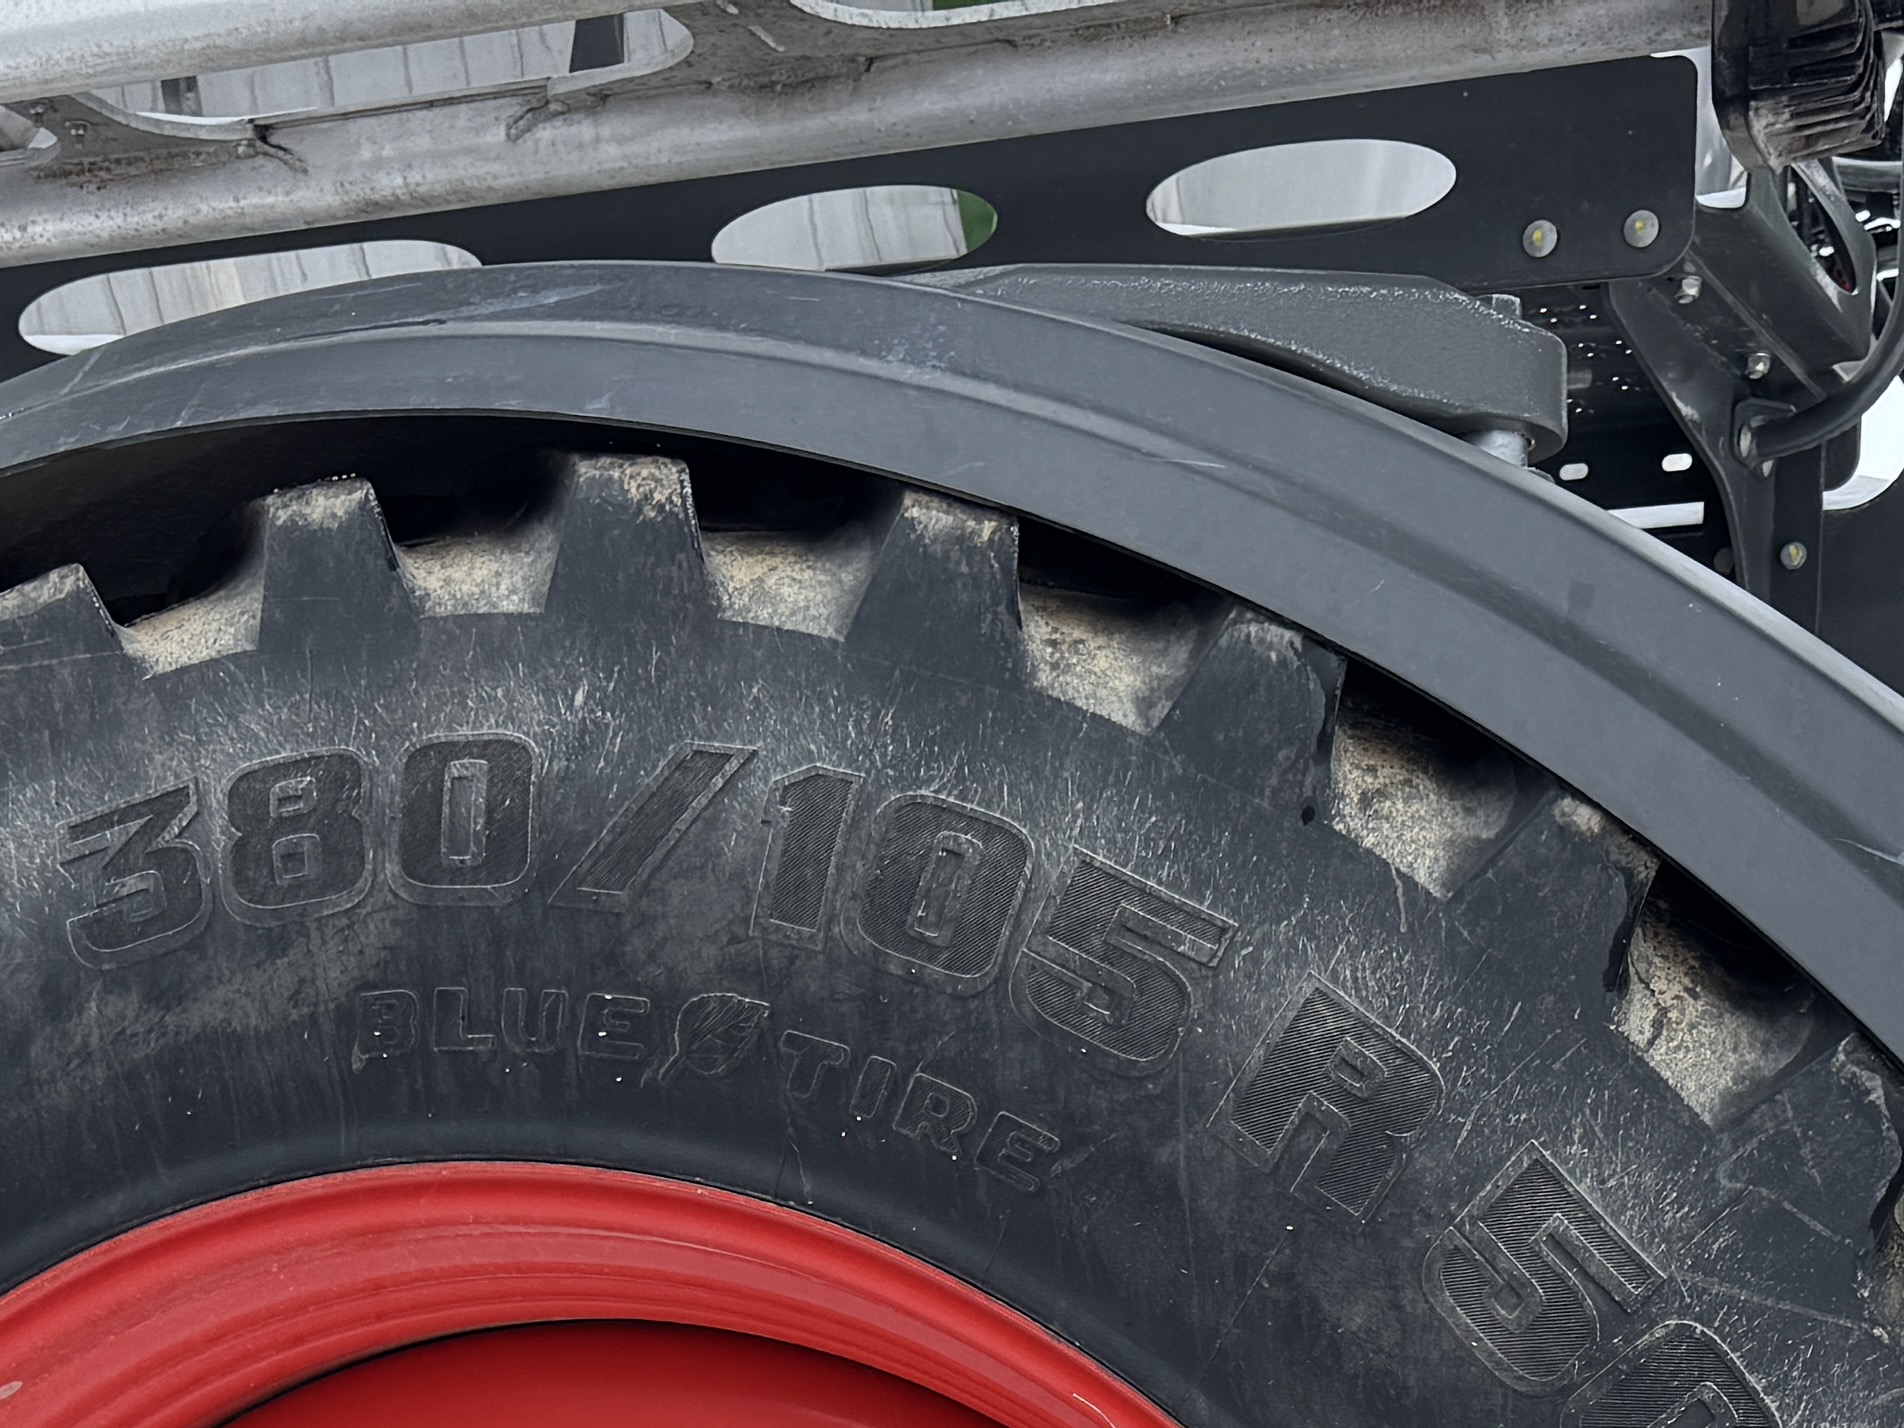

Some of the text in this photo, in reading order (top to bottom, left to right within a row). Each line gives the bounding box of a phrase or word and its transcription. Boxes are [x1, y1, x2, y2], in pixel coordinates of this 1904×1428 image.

[56, 730, 1240, 1075] 380/105
[1207, 970, 1446, 1221] R
[354, 986, 1062, 1192] BLUE TIRE
